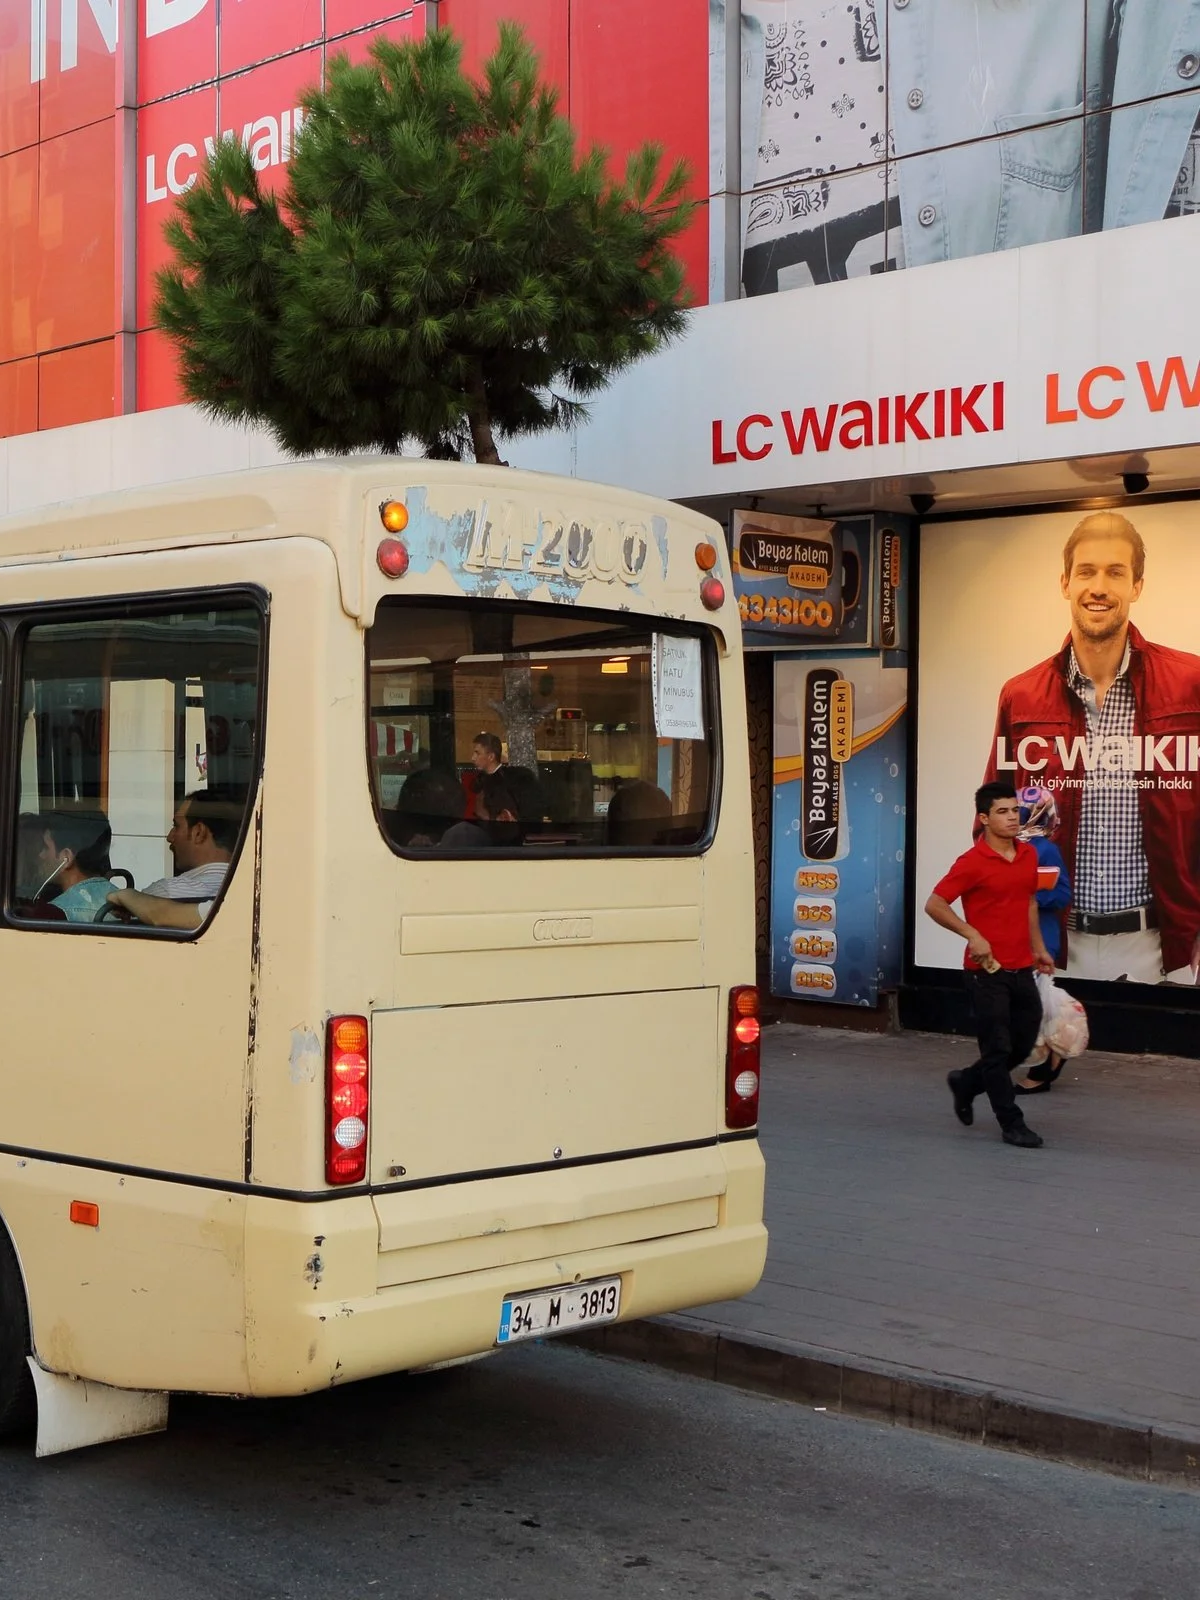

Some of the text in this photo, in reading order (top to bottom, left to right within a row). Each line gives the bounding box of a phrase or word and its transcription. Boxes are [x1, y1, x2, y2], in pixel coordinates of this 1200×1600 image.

[146, 143, 198, 203] LC
[1045, 366, 1126, 424] LC
[712, 414, 775, 465] LC
[758, 540, 829, 565] Beyaz Kalem
[790, 569, 826, 584] AKADEMİ
[882, 535, 892, 624] Beyaz Kalem
[835, 686, 847, 757] AKADEMİ
[809, 680, 830, 823] Beyaz Kalem
[997, 735, 1049, 771] LC
[1158, 776, 1193, 790] hakkı
[798, 871, 838, 890] KPSS
[797, 905, 832, 922] DGS
[512, 1302, 533, 1334] 34
[547, 1296, 562, 1328] M
[578, 1286, 617, 1319] 3813
